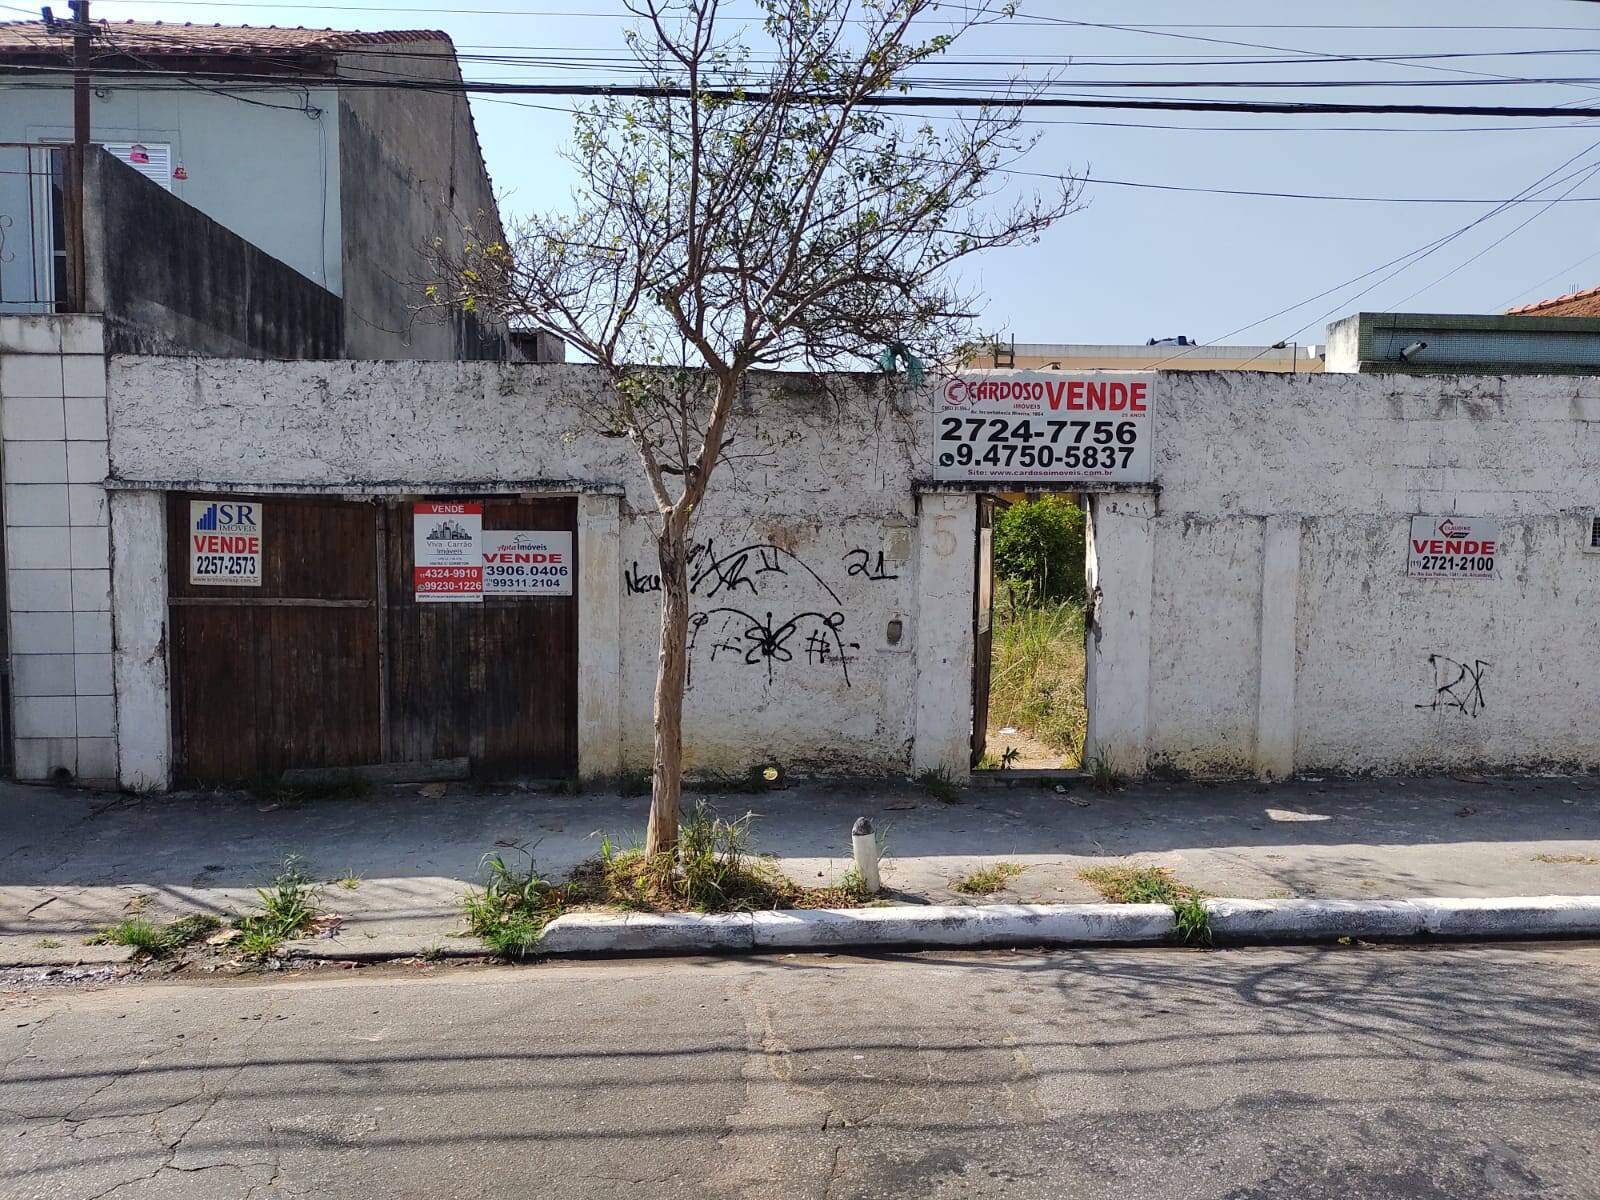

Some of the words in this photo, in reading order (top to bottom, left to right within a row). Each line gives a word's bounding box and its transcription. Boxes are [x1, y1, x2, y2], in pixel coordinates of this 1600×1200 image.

[968, 381, 1044, 401] CARDOSO
[1045, 381, 1147, 411] VENDE
[940, 418, 1137, 444] 2724-7756
[956, 443, 1135, 469] 9.4750-5837
[218, 504, 257, 525] SR
[431, 505, 465, 513] VENDE
[193, 535, 259, 554] VENDE
[517, 543, 548, 551] Imóveis
[1412, 540, 1495, 555] VENDE
[196, 556, 256, 575] 2257-2573
[482, 553, 562, 563] VENDE
[1421, 555, 1494, 571] 2721-2100
[425, 569, 478, 578] 4324-9910
[486, 566, 568, 576] 3906.0406
[424, 581, 482, 590] 99230-1226
[492, 578, 561, 588] 99311.2104
